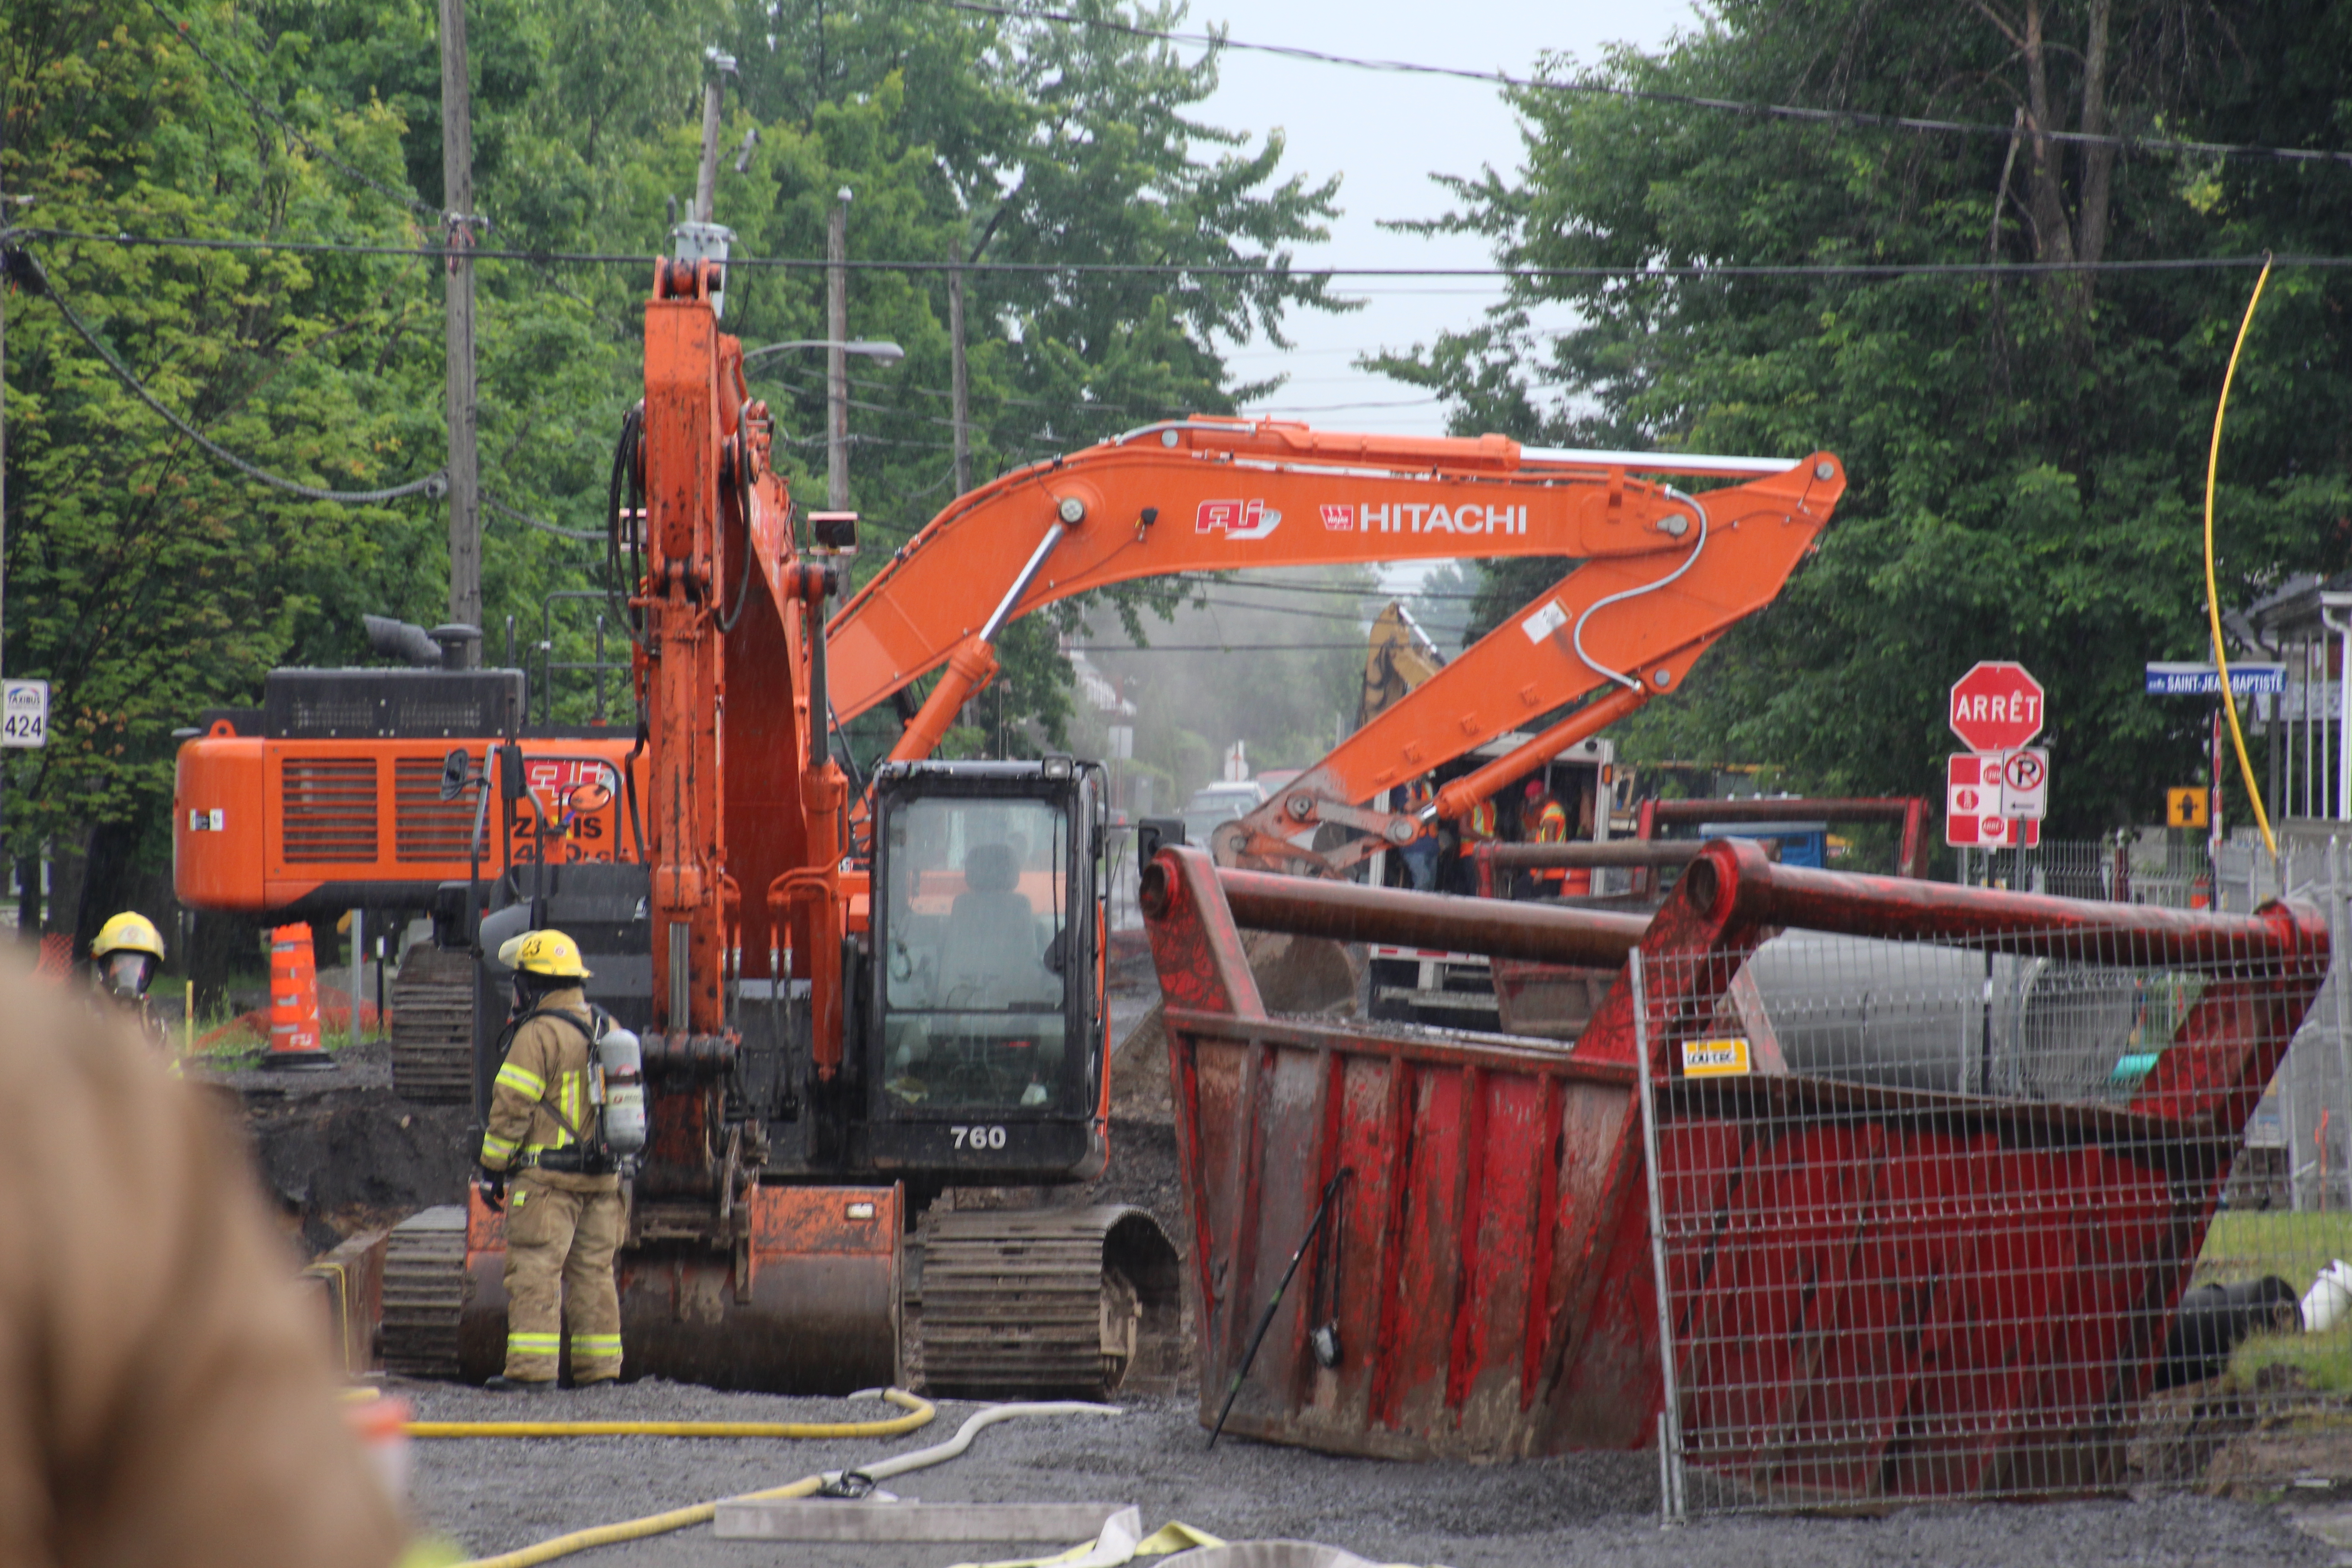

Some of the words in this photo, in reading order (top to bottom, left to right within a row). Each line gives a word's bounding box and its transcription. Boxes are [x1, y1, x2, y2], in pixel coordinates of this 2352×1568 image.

[1360, 503, 1527, 534] HITACHI
[2167, 674, 2283, 692] SAINT-JEA-BAPTISTE
[1955, 690, 2038, 723] ARRÊT
[5, 715, 42, 737] 424
[514, 817, 602, 838] ZIS
[950, 1125, 1006, 1150] 760
